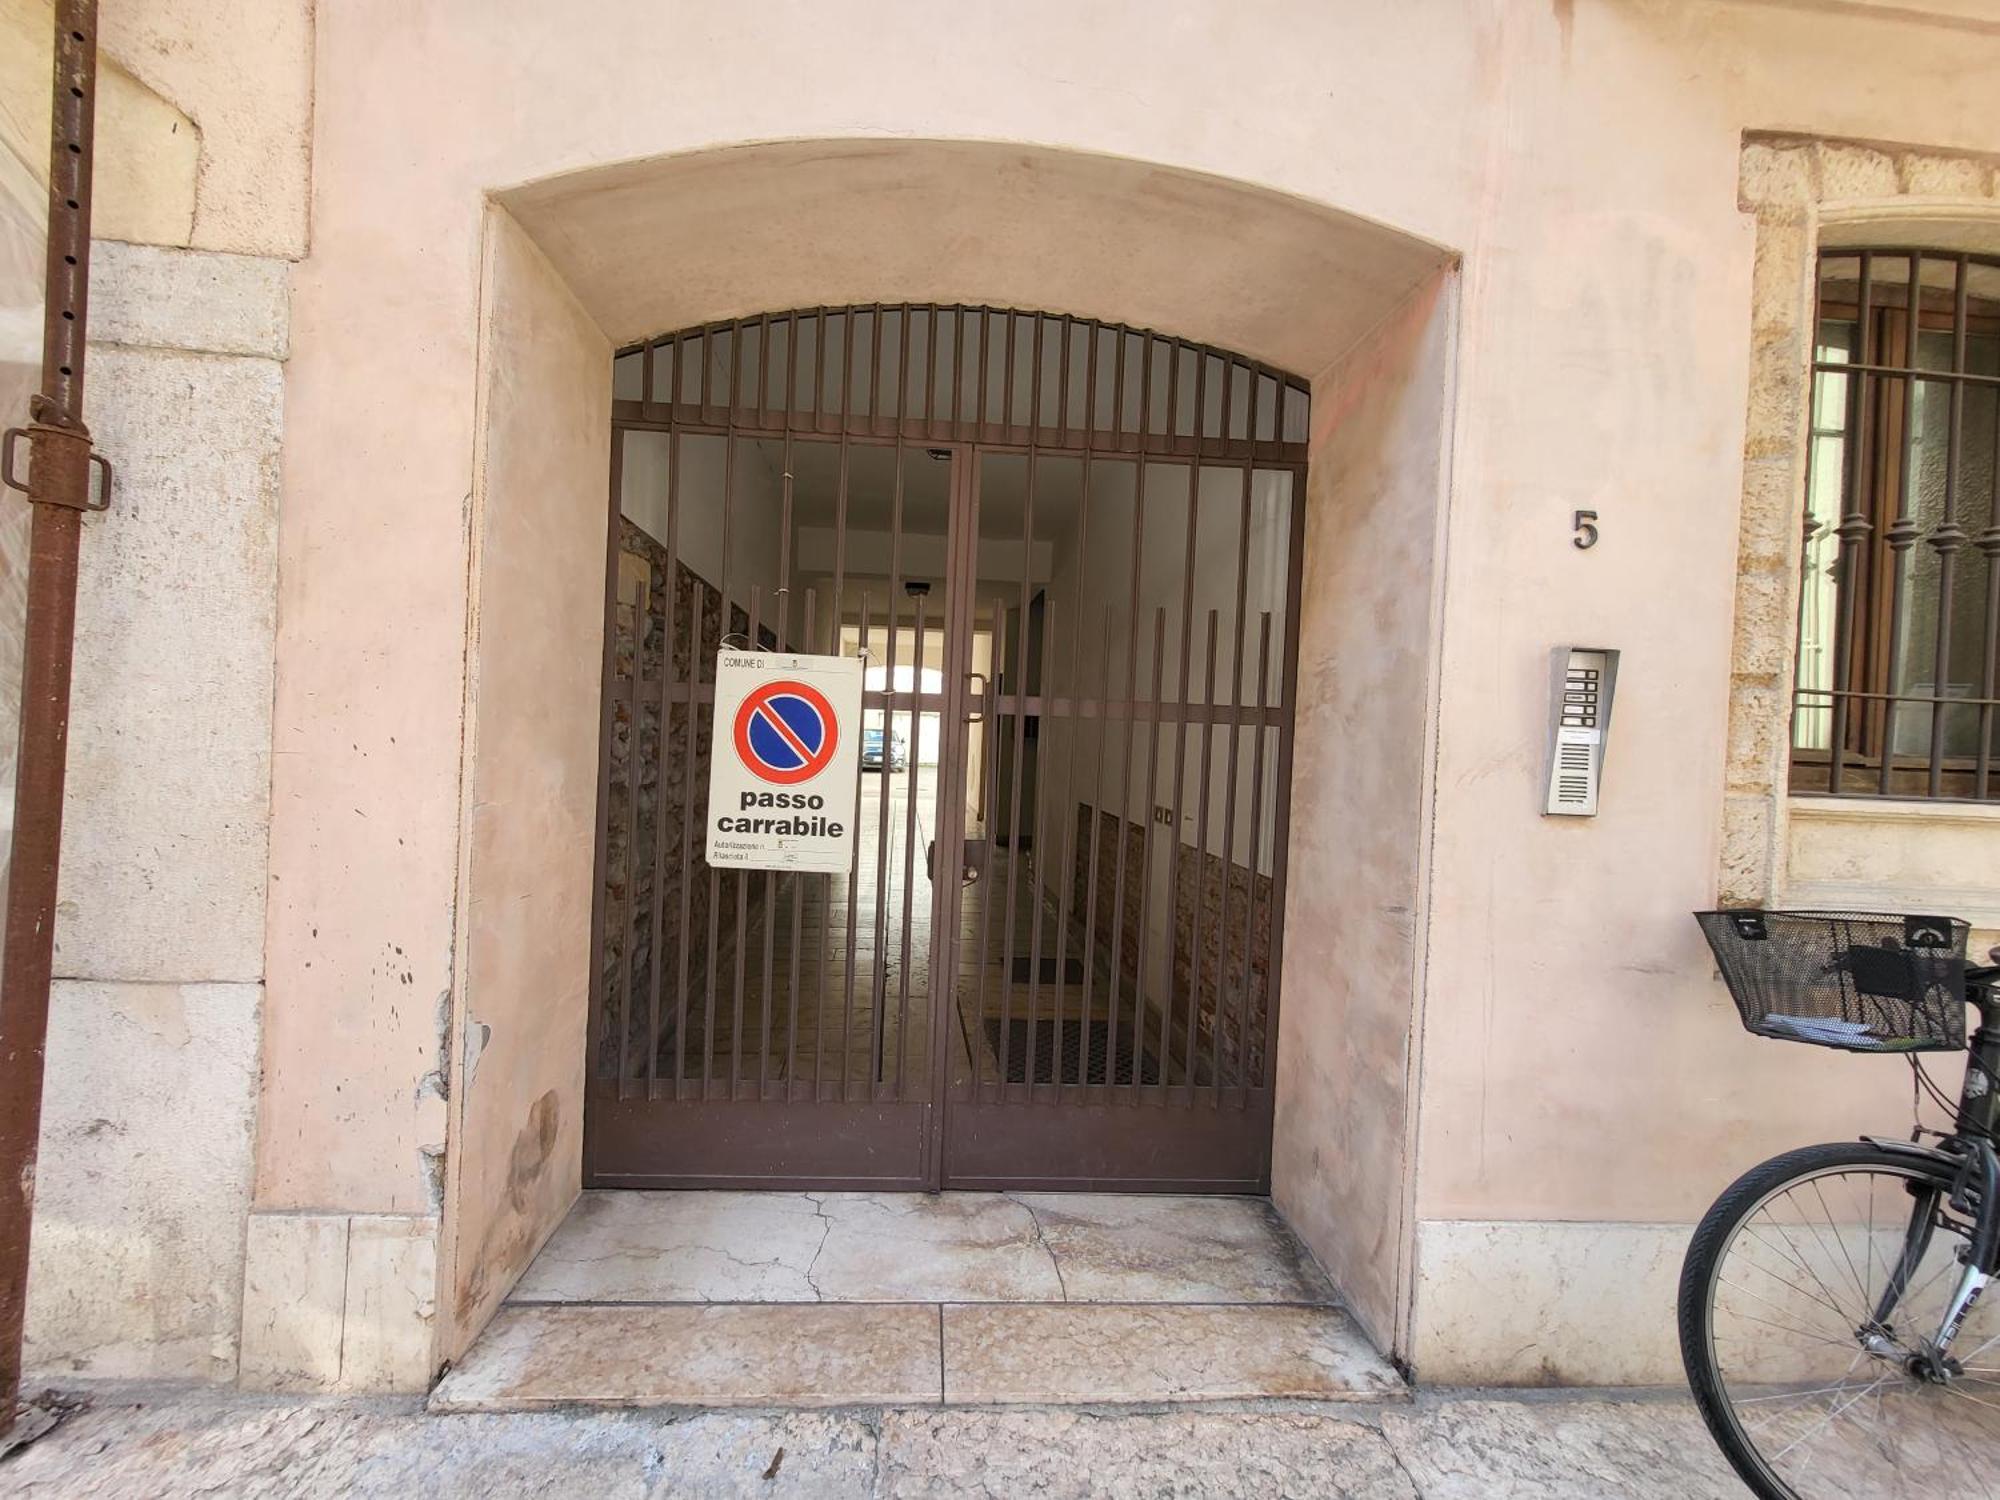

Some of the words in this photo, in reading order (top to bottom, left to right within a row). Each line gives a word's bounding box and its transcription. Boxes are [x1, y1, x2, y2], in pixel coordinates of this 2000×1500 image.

[1574, 510, 1598, 549] 5
[723, 657, 755, 669] COMUNE
[756, 659, 765, 669] DI
[740, 791, 824, 811] passo
[717, 815, 844, 838] carrabile
